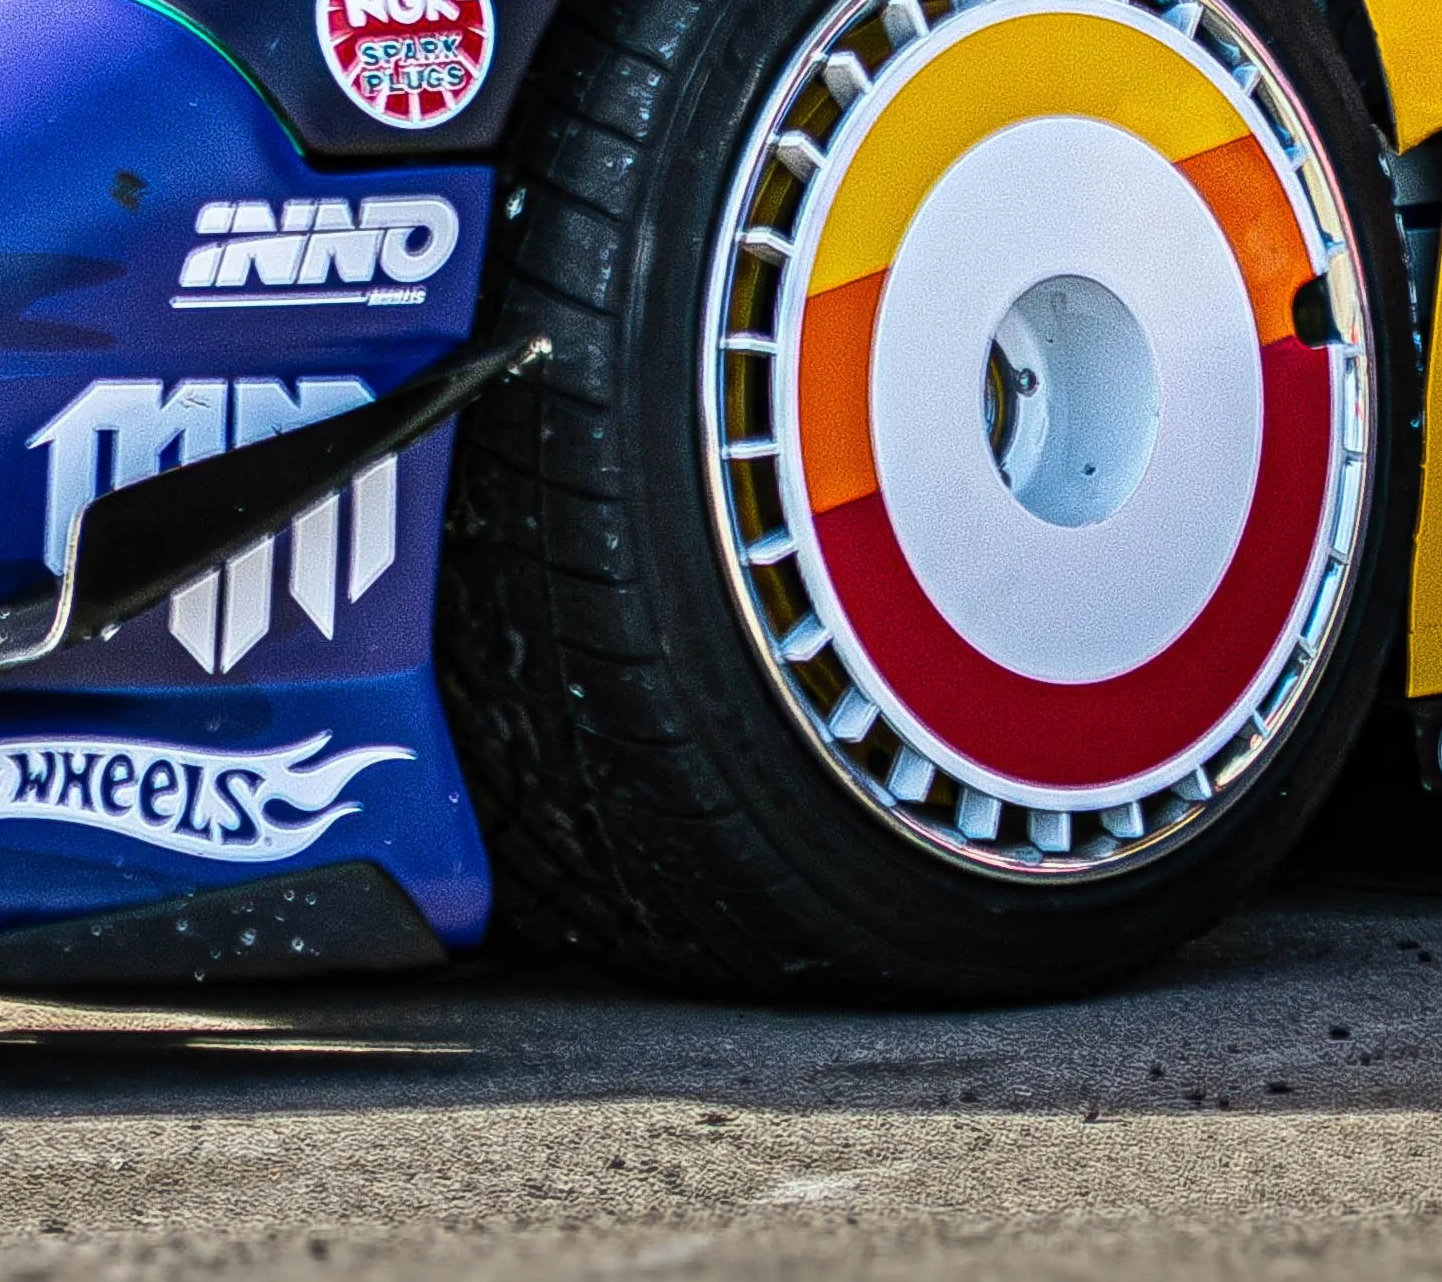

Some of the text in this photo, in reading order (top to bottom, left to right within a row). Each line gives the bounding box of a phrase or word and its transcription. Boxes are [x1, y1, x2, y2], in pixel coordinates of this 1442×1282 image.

[361, 36, 460, 66] SPARK
[364, 66, 464, 94] PLUGS
[179, 194, 460, 287] INNO
